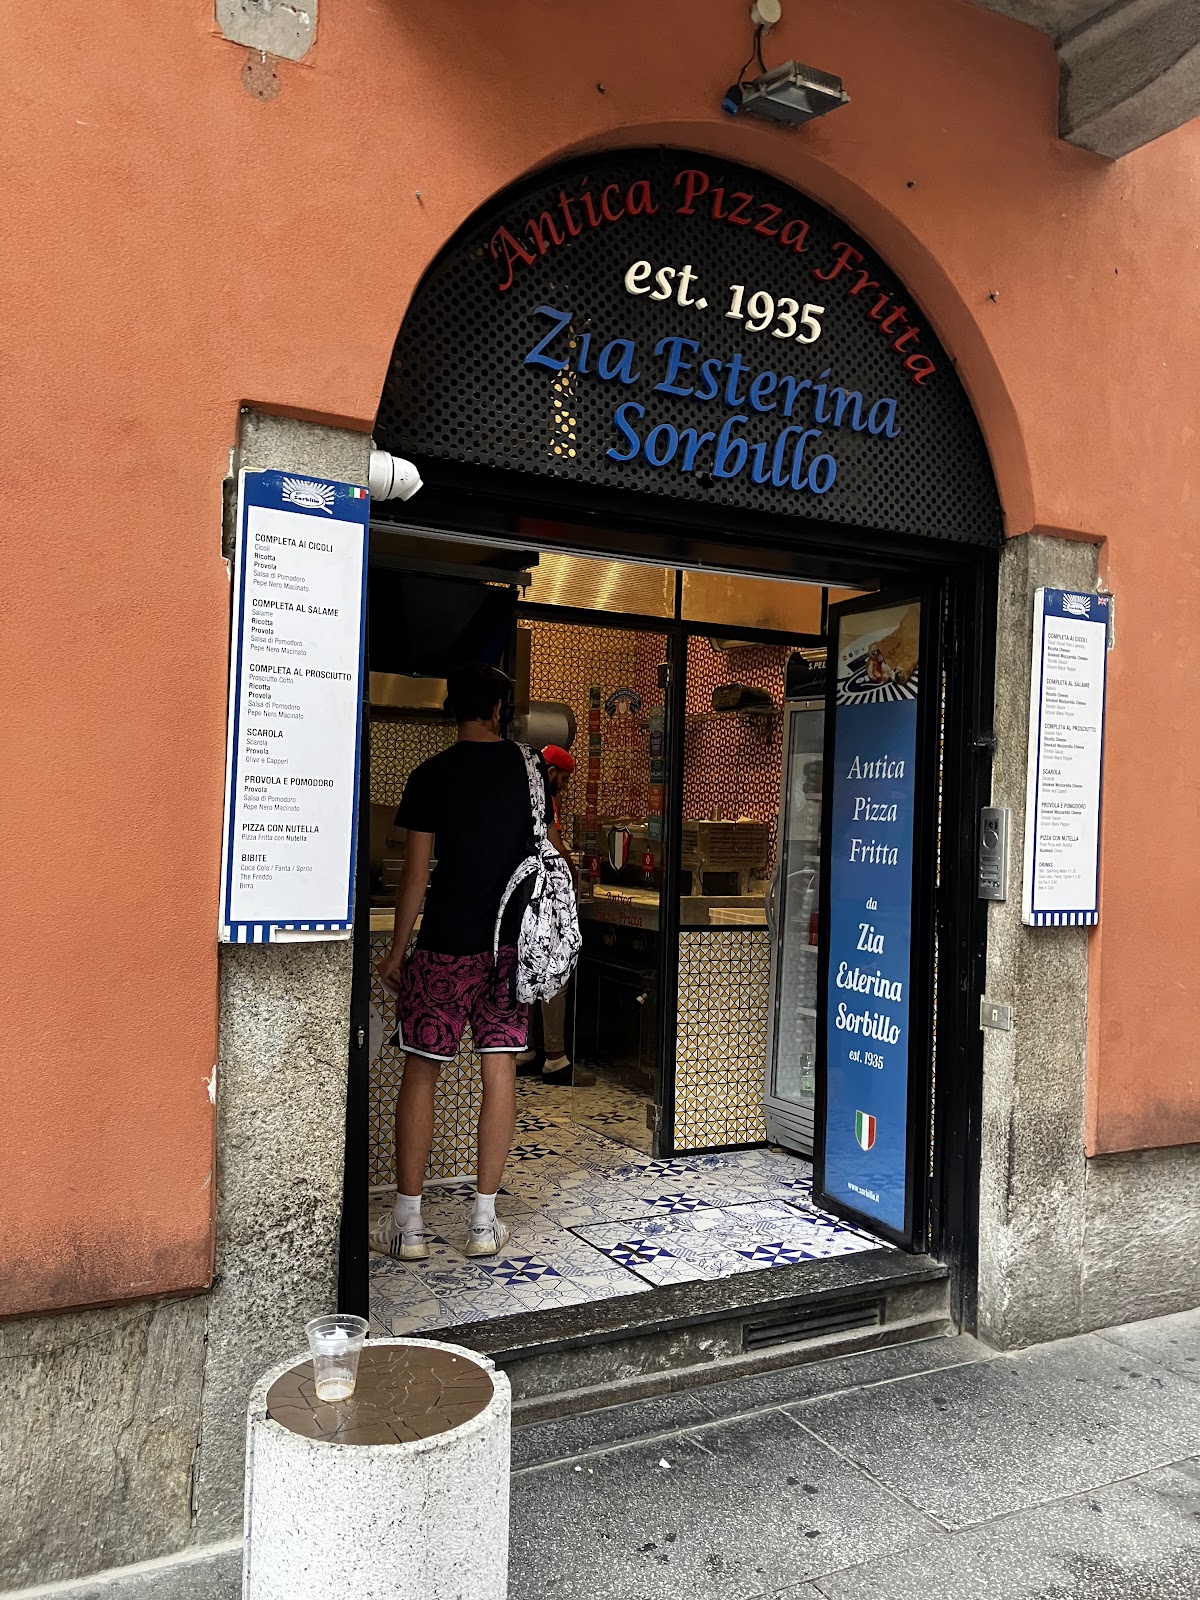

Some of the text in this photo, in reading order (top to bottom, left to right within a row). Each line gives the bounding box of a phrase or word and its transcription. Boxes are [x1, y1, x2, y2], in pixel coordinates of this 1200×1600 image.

[488, 169, 937, 387] Antica Pizza Fritta
[624, 259, 826, 345] est. 1935
[522, 304, 902, 440] Zia Esterina
[605, 401, 837, 494] Sorbillo
[255, 544, 270, 552] Cicoli
[256, 534, 296, 547] COMPLETA
[309, 542, 332, 552] CICOLI
[255, 553, 275, 561] Ricotta
[254, 561, 276, 570] Provola
[254, 570, 269, 578] Salsa
[278, 573, 305, 583] Pomodoro
[253, 579, 267, 587] Pepe
[284, 583, 309, 592] Macinato
[252, 609, 273, 617] Salame
[253, 599, 338, 617] COMPLETA AL SALAME
[252, 618, 273, 626] Ricotta
[252, 627, 274, 635] Provola
[251, 635, 266, 643] Salsa
[275, 638, 302, 647] Pomodoro
[251, 644, 264, 652] Pepe
[281, 648, 306, 656] Macinato
[249, 674, 277, 682] Prosciutto
[250, 664, 291, 675] COMPLETA
[306, 670, 351, 681] PROSCIUTTO
[272, 702, 300, 710] Pomodoro
[248, 709, 261, 717] Pepe
[247, 728, 283, 738] SCAROLA
[267, 757, 288, 765] Capperi
[847, 756, 904, 780] Antica
[245, 776, 281, 784] PROVOLA
[291, 778, 333, 787] POMODORO
[852, 798, 898, 822] Pizza
[286, 825, 319, 833] NUTELLA
[849, 839, 898, 865] Fritta
[866, 897, 877, 910] da
[857, 923, 884, 954] Zia
[836, 961, 902, 1002] Esterina
[836, 1002, 901, 1044] Sorbillo
[849, 1048, 885, 1070] est. 1935
[847, 1182, 881, 1203] www.sorbillo.it
